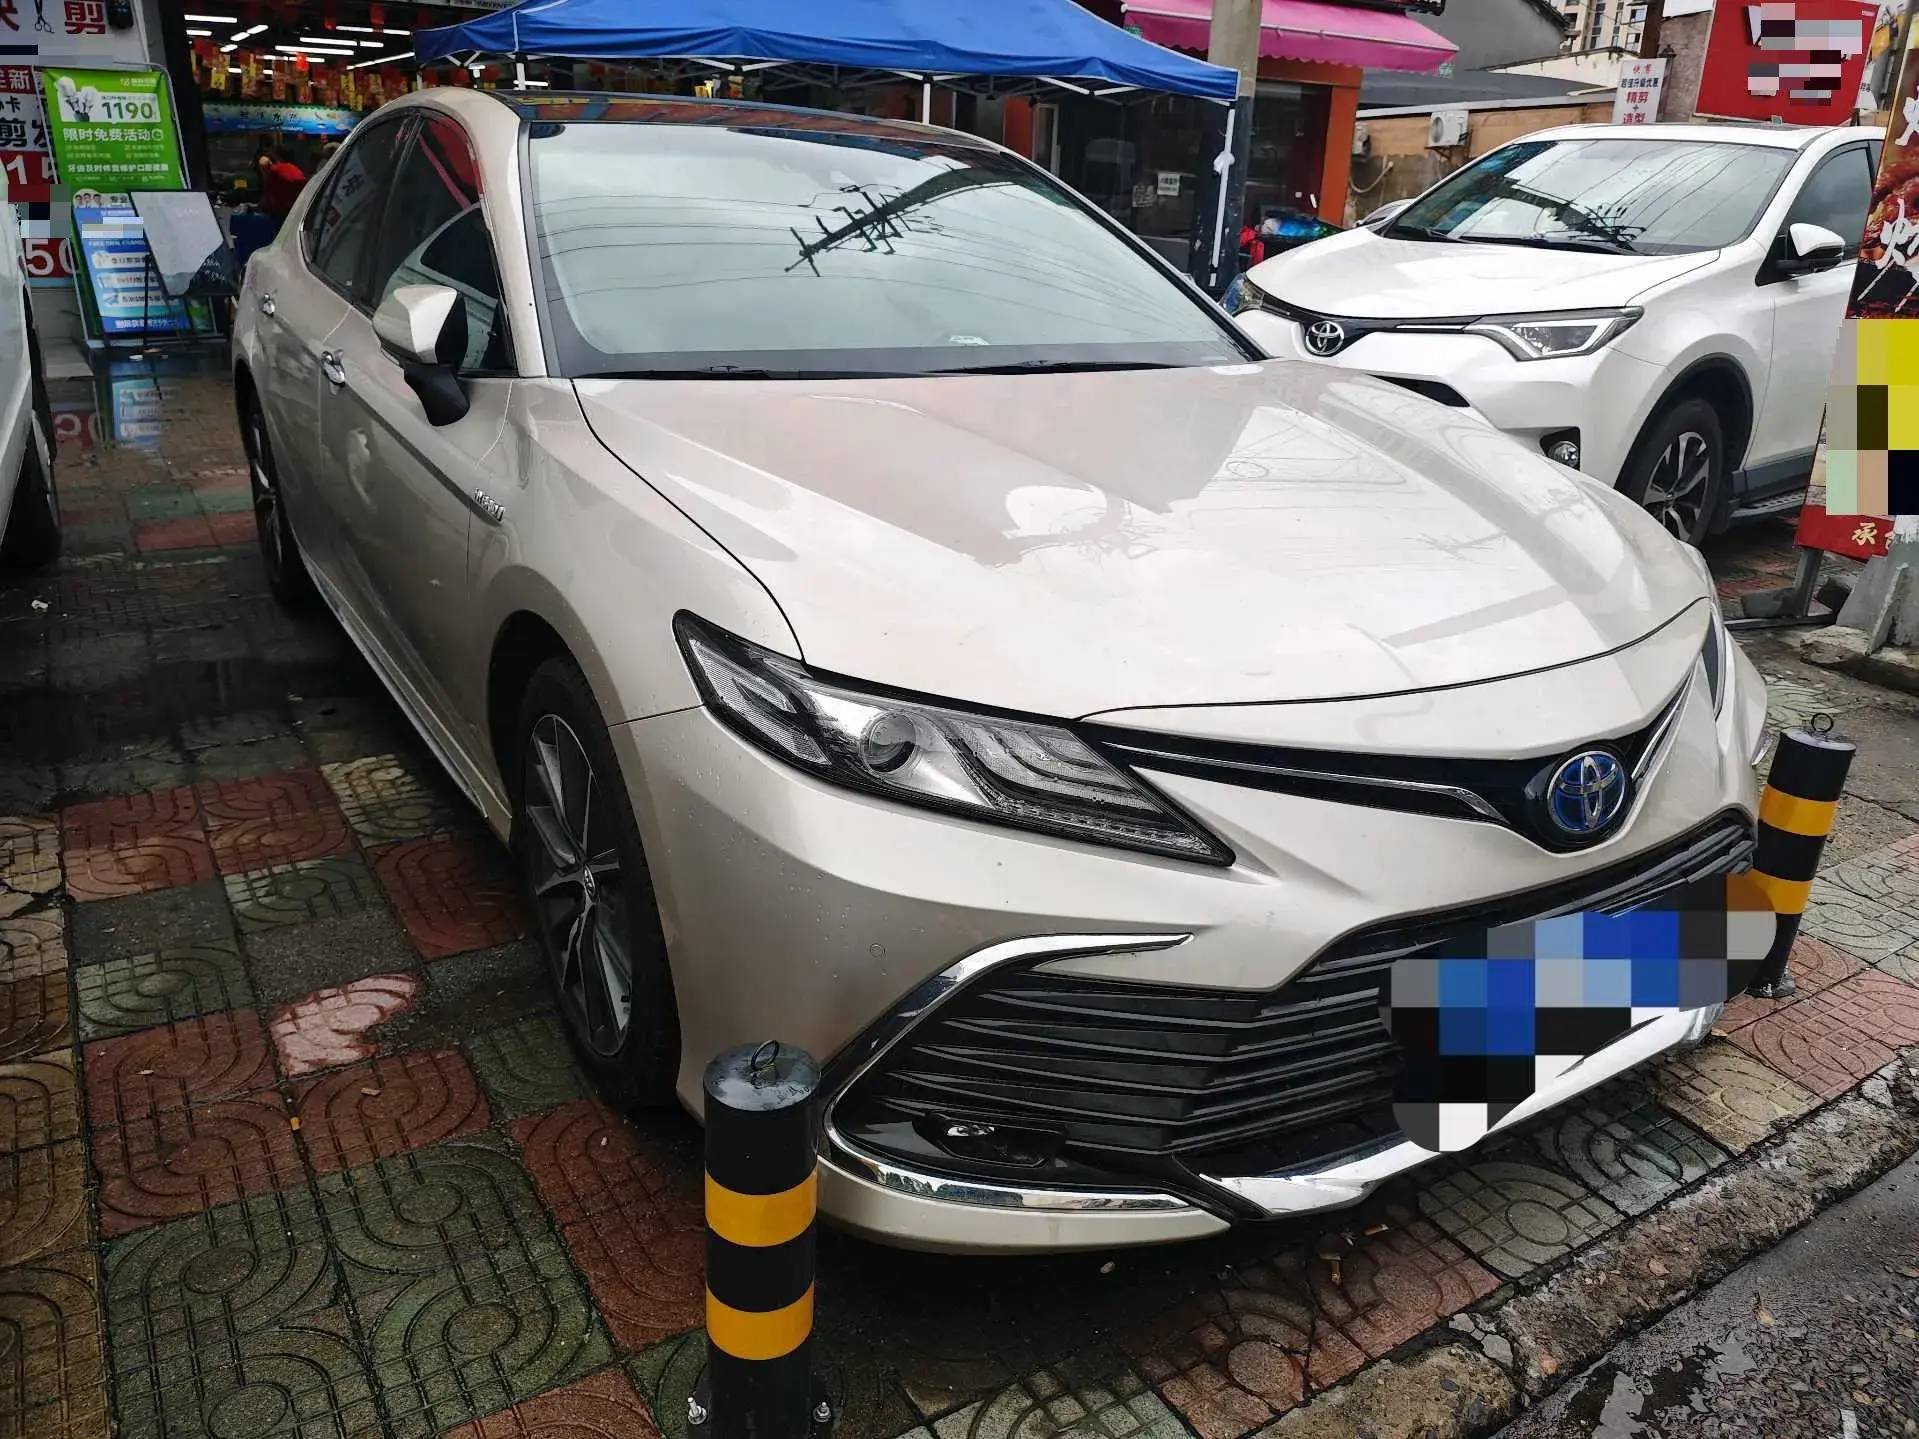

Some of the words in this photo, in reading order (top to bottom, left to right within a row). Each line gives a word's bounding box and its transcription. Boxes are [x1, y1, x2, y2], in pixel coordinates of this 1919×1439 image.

[102, 101, 153, 120] 1190
[63, 127, 150, 142] 限时免费活动
